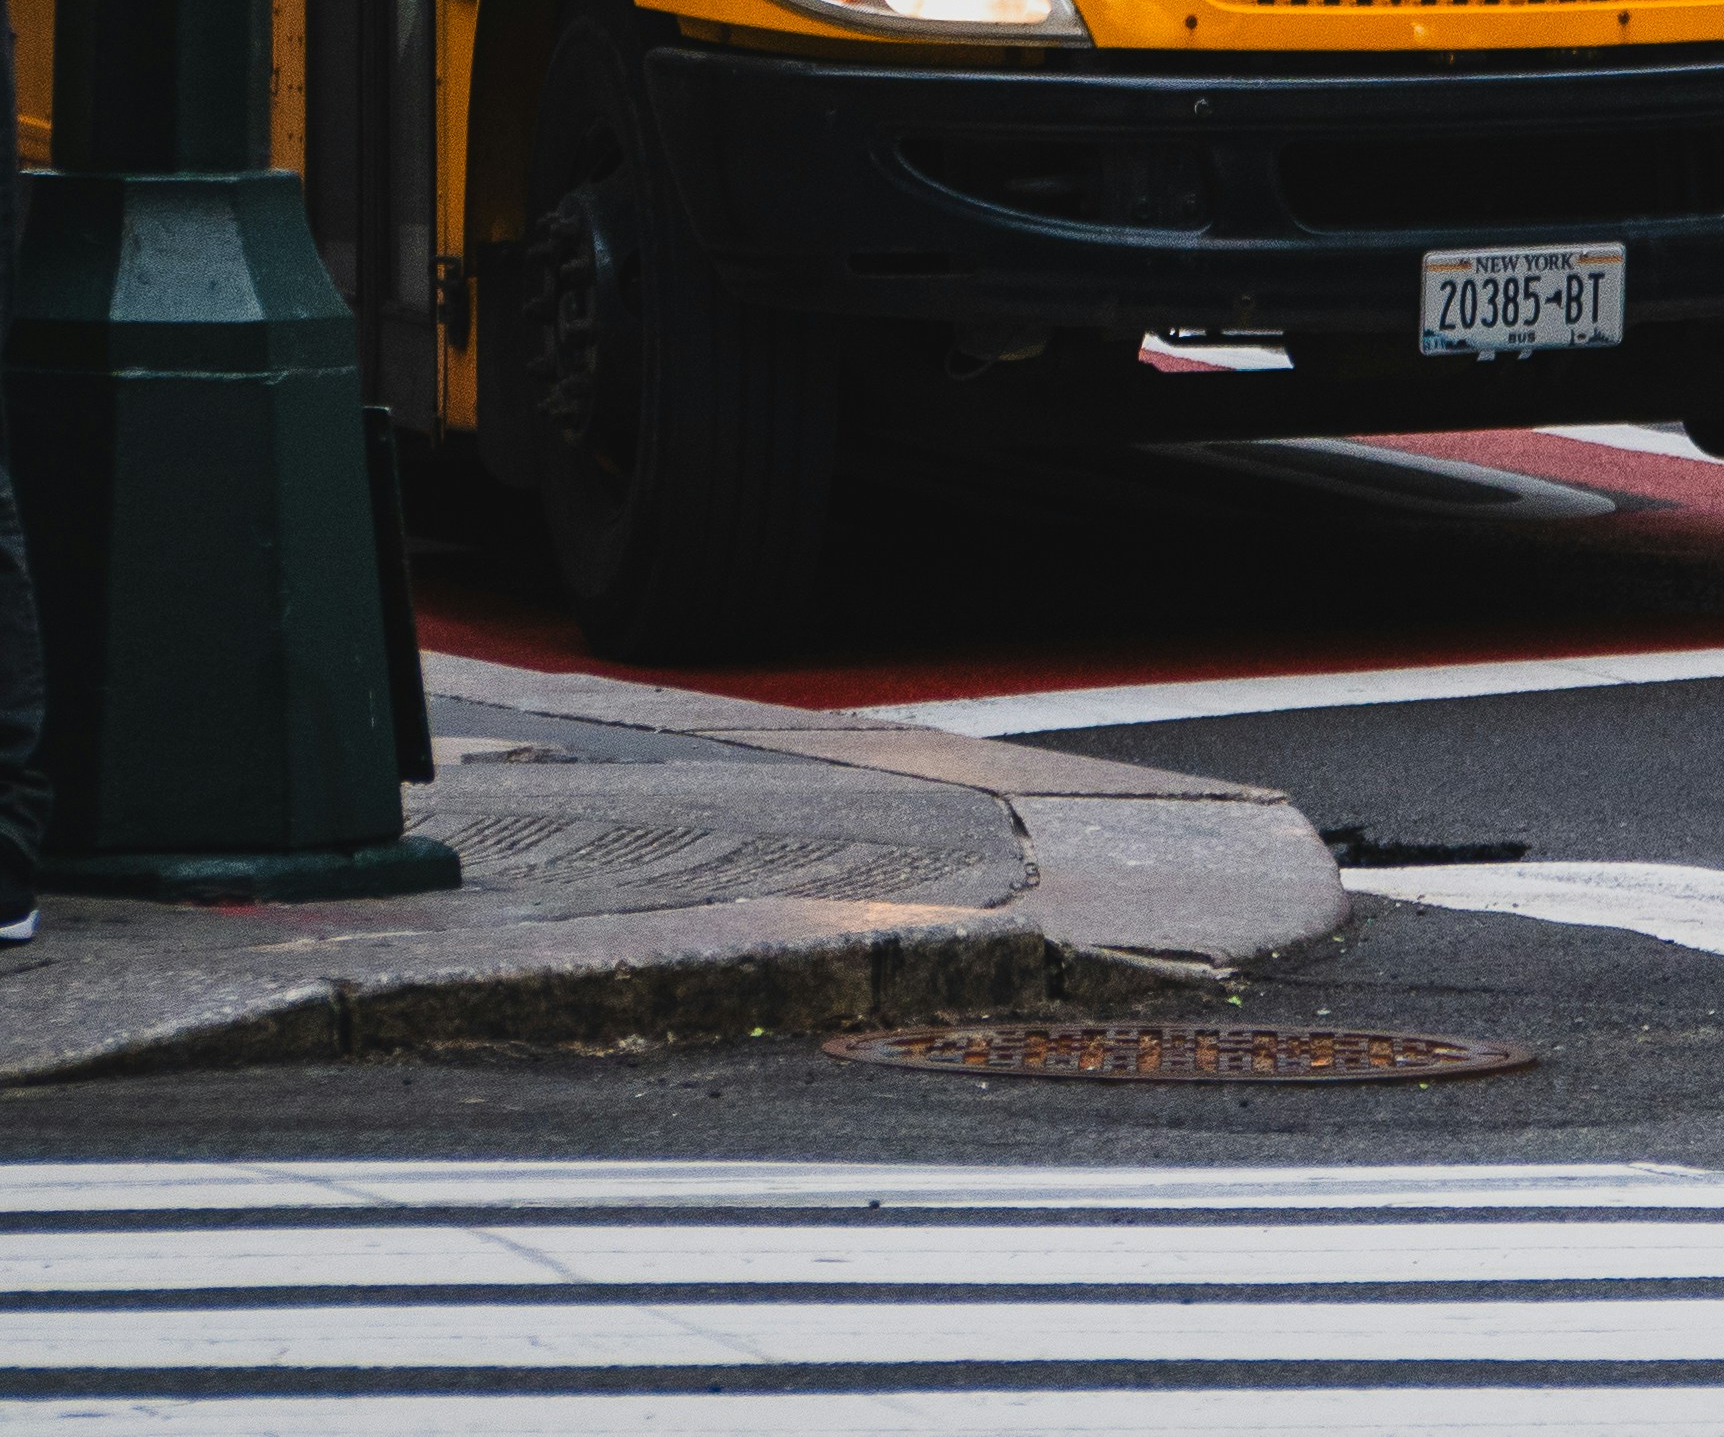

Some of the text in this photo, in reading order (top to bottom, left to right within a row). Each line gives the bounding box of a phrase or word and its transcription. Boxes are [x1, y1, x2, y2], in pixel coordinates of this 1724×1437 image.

[1475, 252, 1575, 274] NEW YORK
[1508, 331, 1536, 344] BUS
